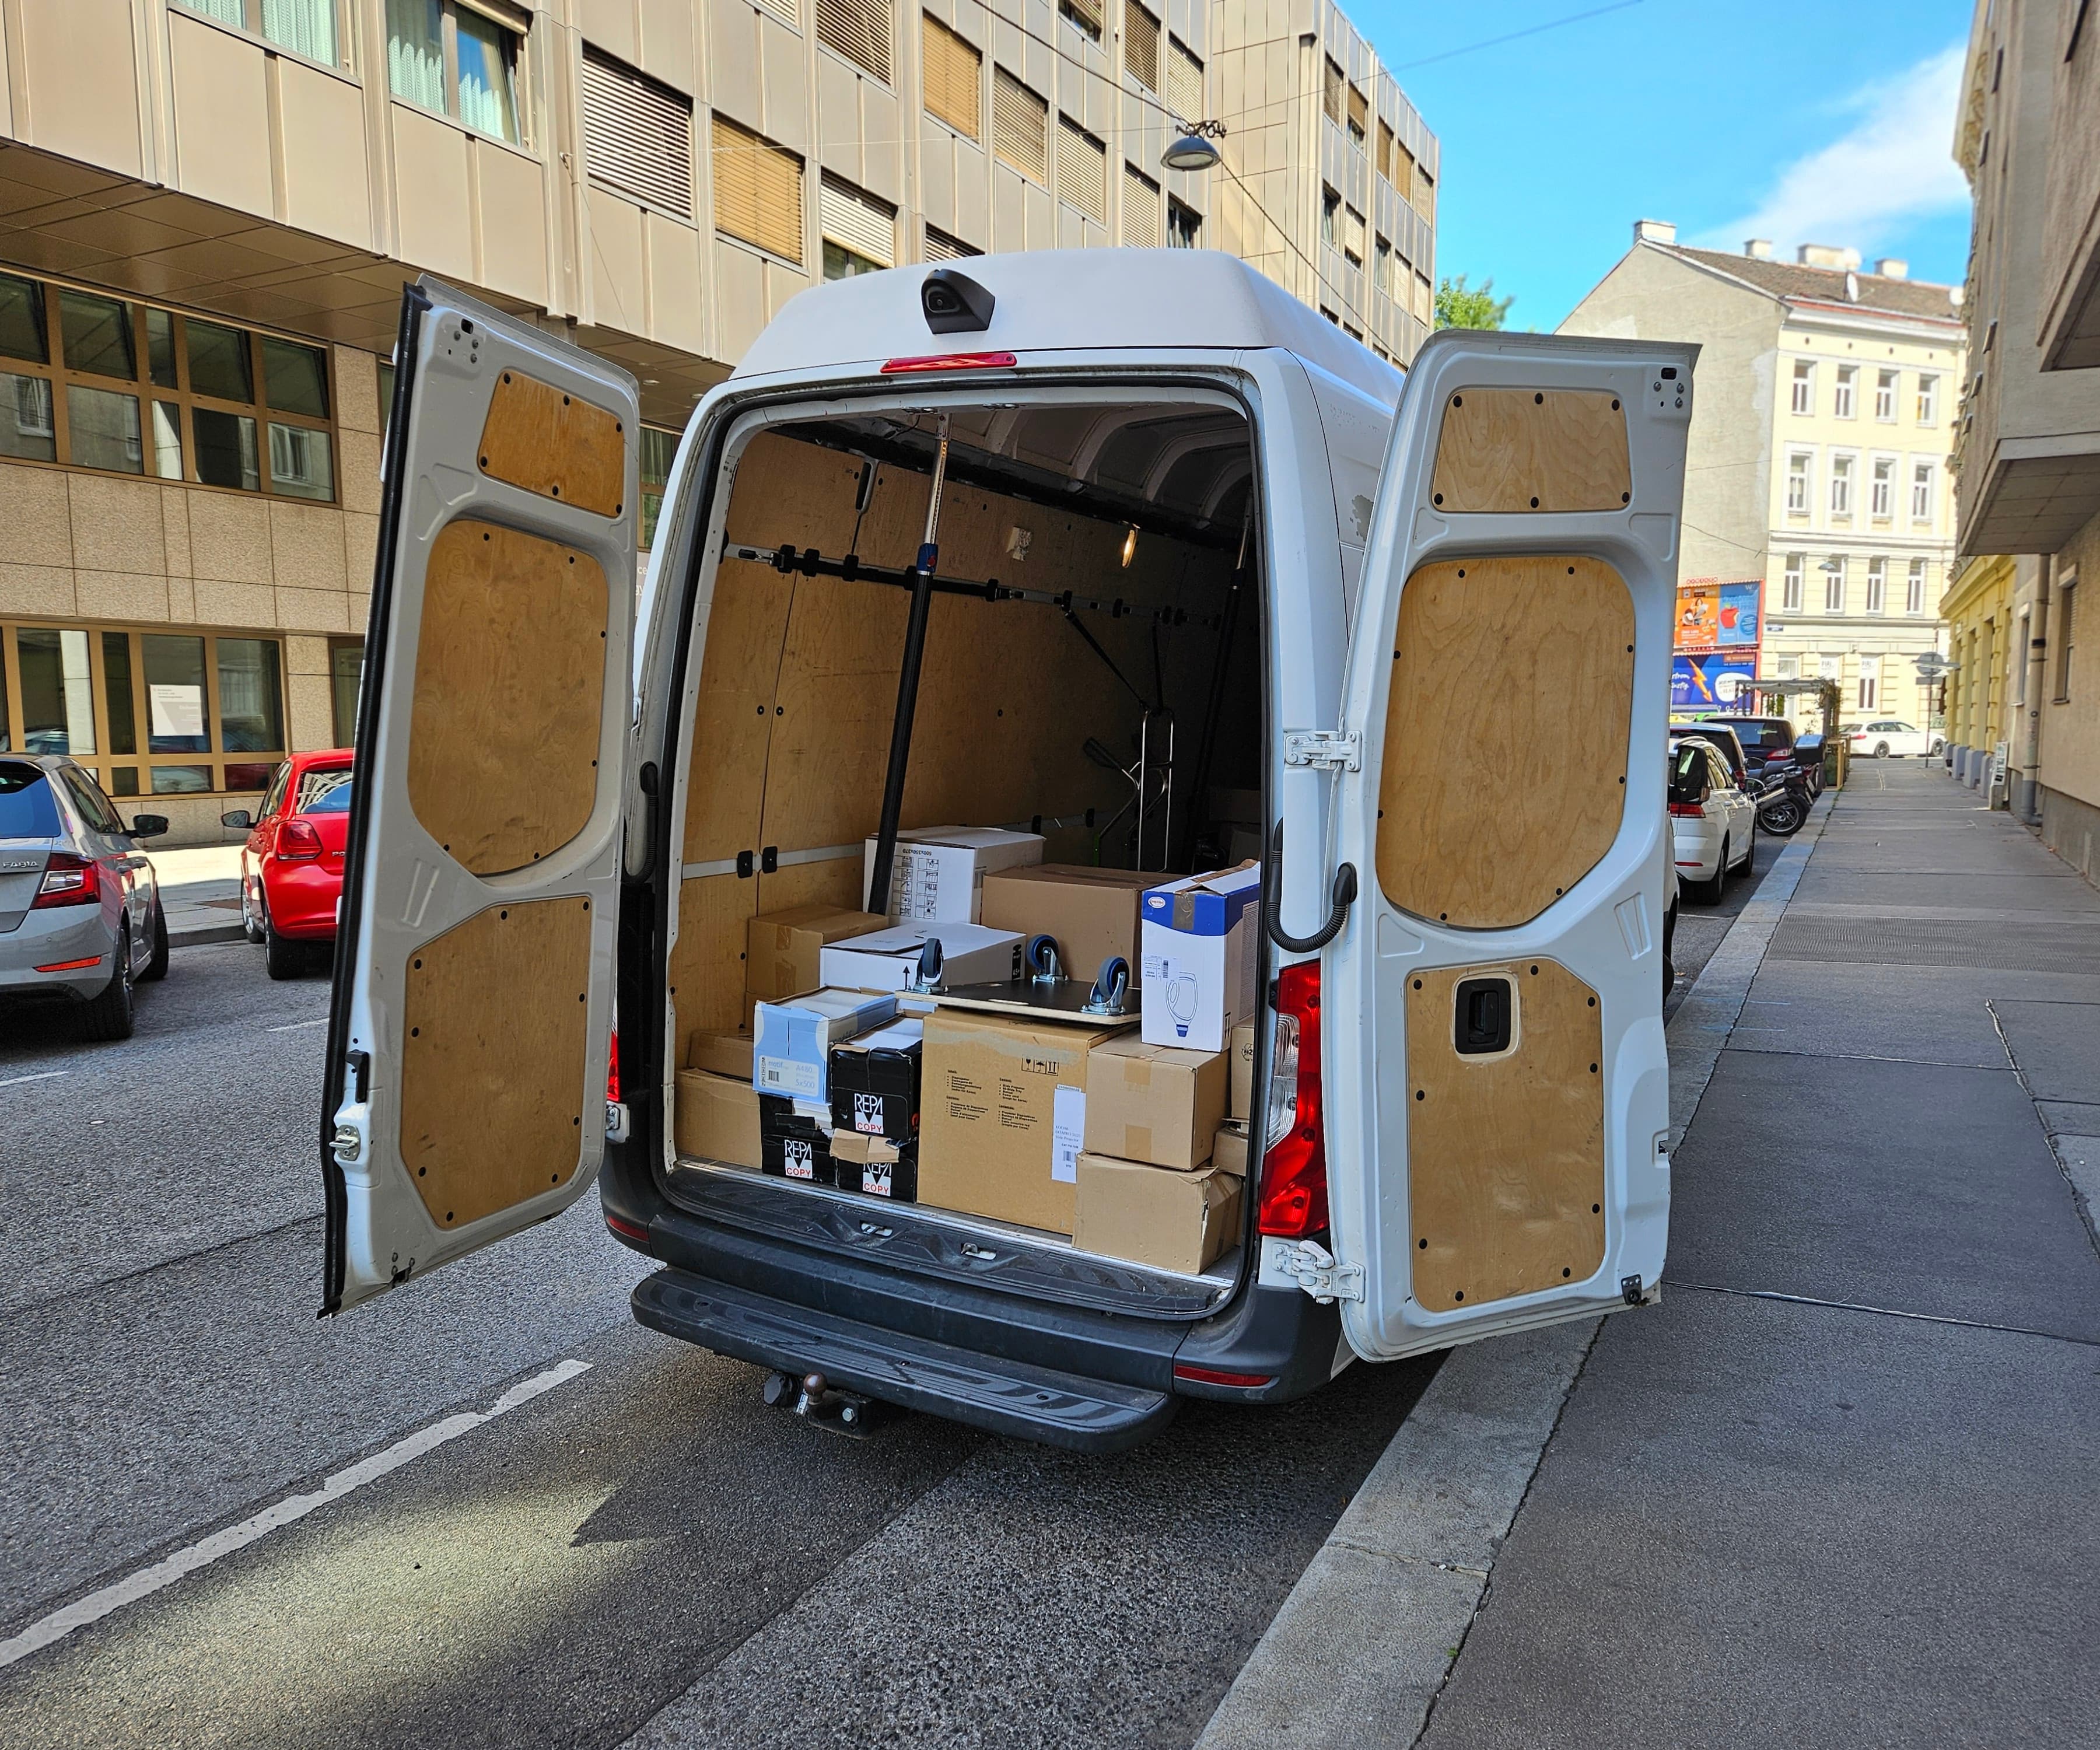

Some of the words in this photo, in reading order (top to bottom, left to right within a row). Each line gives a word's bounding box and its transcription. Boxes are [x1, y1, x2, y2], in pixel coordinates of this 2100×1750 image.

[856, 1122, 882, 1133] COPY
[786, 1167, 811, 1177] COPY
[864, 1182, 889, 1194] COPY
